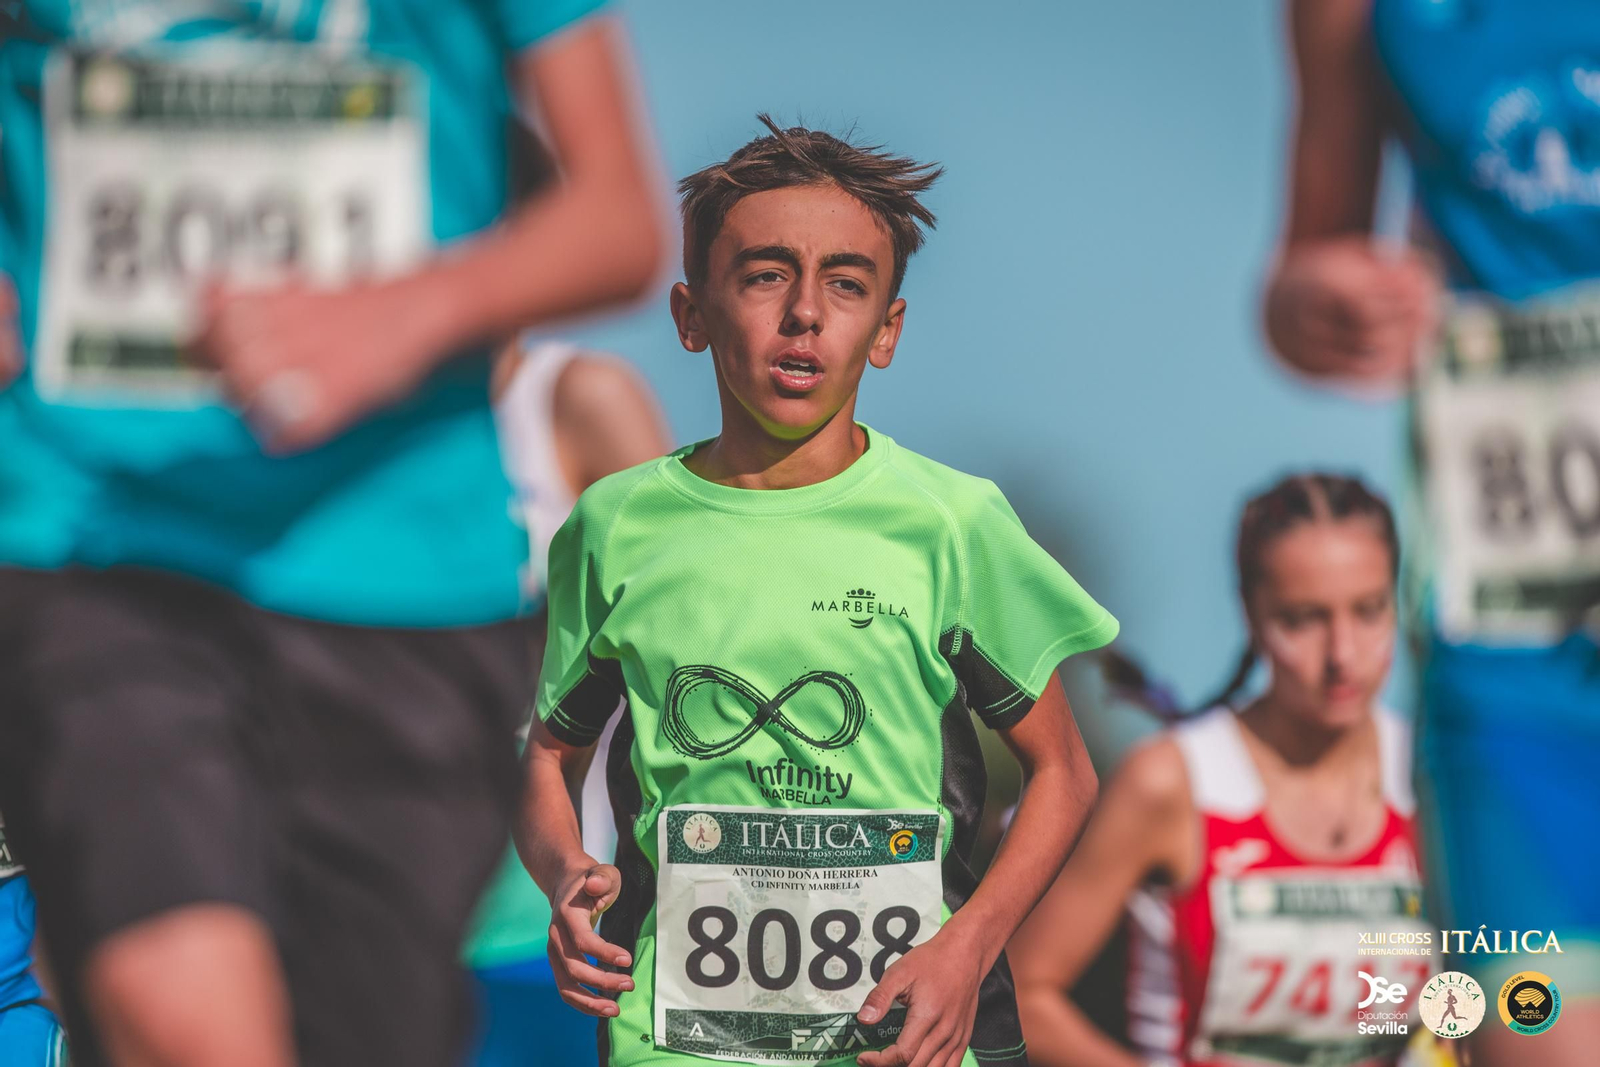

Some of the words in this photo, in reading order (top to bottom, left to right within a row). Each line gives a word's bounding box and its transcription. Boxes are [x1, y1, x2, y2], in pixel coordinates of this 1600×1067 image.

[811, 600, 909, 618] MARBELLA
[745, 757, 853, 800] Infinity
[760, 786, 832, 805] MARBELLA
[741, 817, 872, 850] ITÁLICA
[742, 848, 804, 858] INTERNATIONAL
[807, 850, 832, 858] CROSS
[834, 849, 872, 857] COUNTRY
[732, 867, 785, 879] ANTONIO
[787, 868, 820, 880] DOÑA
[823, 868, 878, 879] HERRERA
[751, 880, 764, 888] CD
[766, 881, 806, 890] INFINITY
[808, 881, 860, 891] MARBELLA
[685, 905, 921, 991] 8088
[716, 1049, 766, 1061] FEDERACIÓN
[769, 1053, 815, 1062] ANDALUZA
